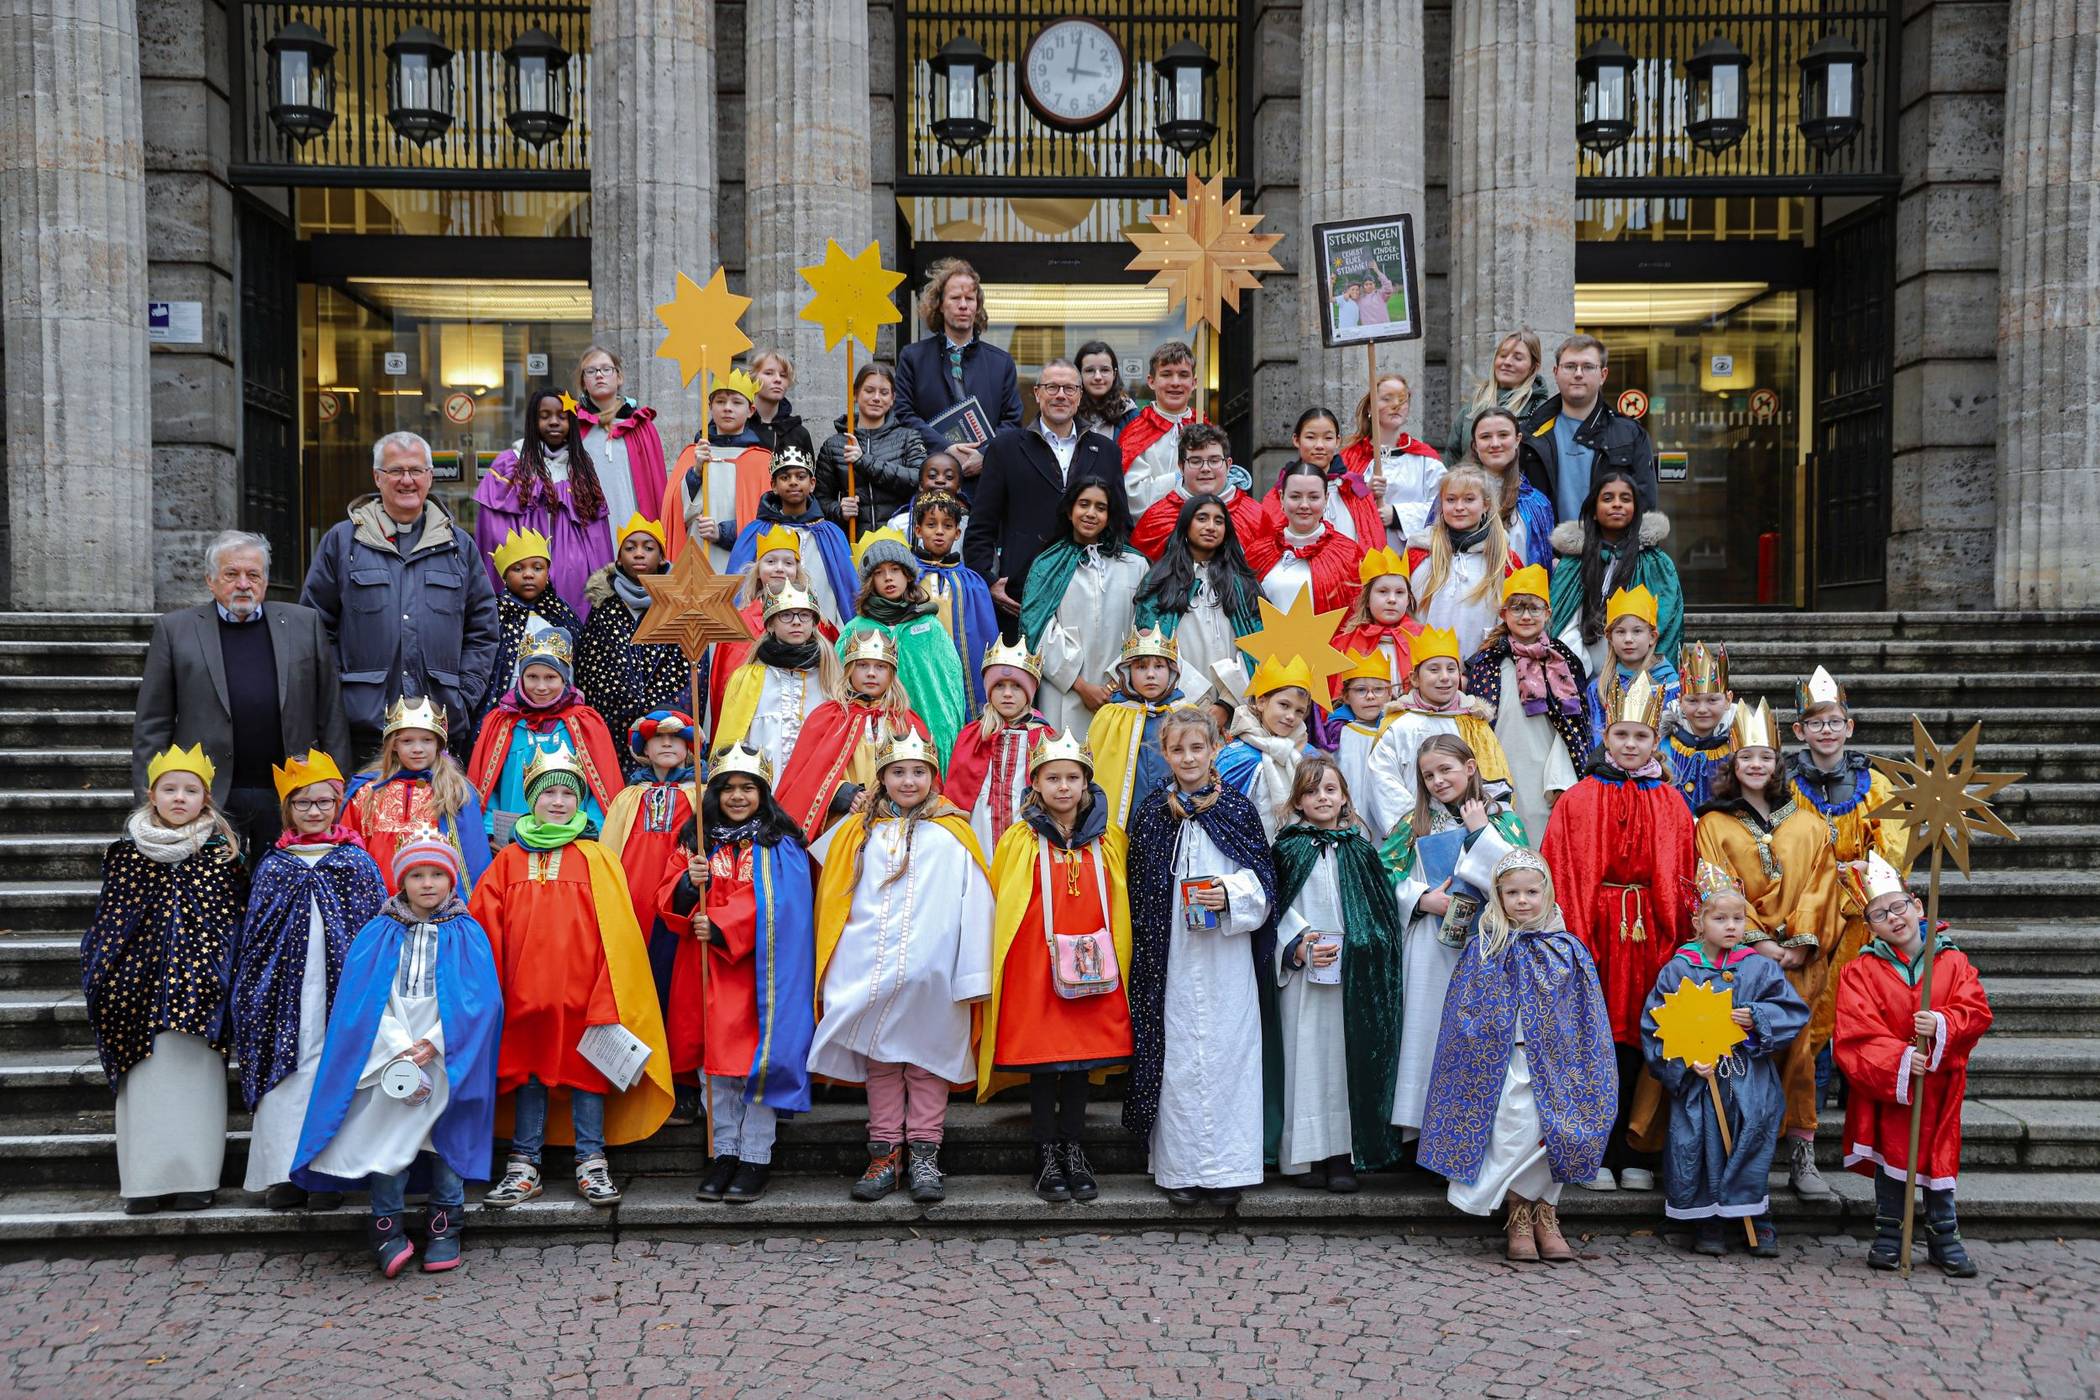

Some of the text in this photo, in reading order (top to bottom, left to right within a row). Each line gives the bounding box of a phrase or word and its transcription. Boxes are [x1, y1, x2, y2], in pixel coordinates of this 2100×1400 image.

[1056, 36, 1065, 48] 11
[1090, 37, 1095, 49] 1
[1041, 47, 1054, 61] 10
[1100, 49, 1108, 62] 2
[1038, 63, 1047, 76] 9
[1104, 65, 1112, 78] 3
[1042, 80, 1051, 93] 8
[1098, 83, 1107, 95] 4
[1055, 93, 1063, 105] 7
[1070, 98, 1079, 111] 6
[1087, 94, 1096, 108] 5
[1328, 228, 1398, 246] STERNSINGEN
